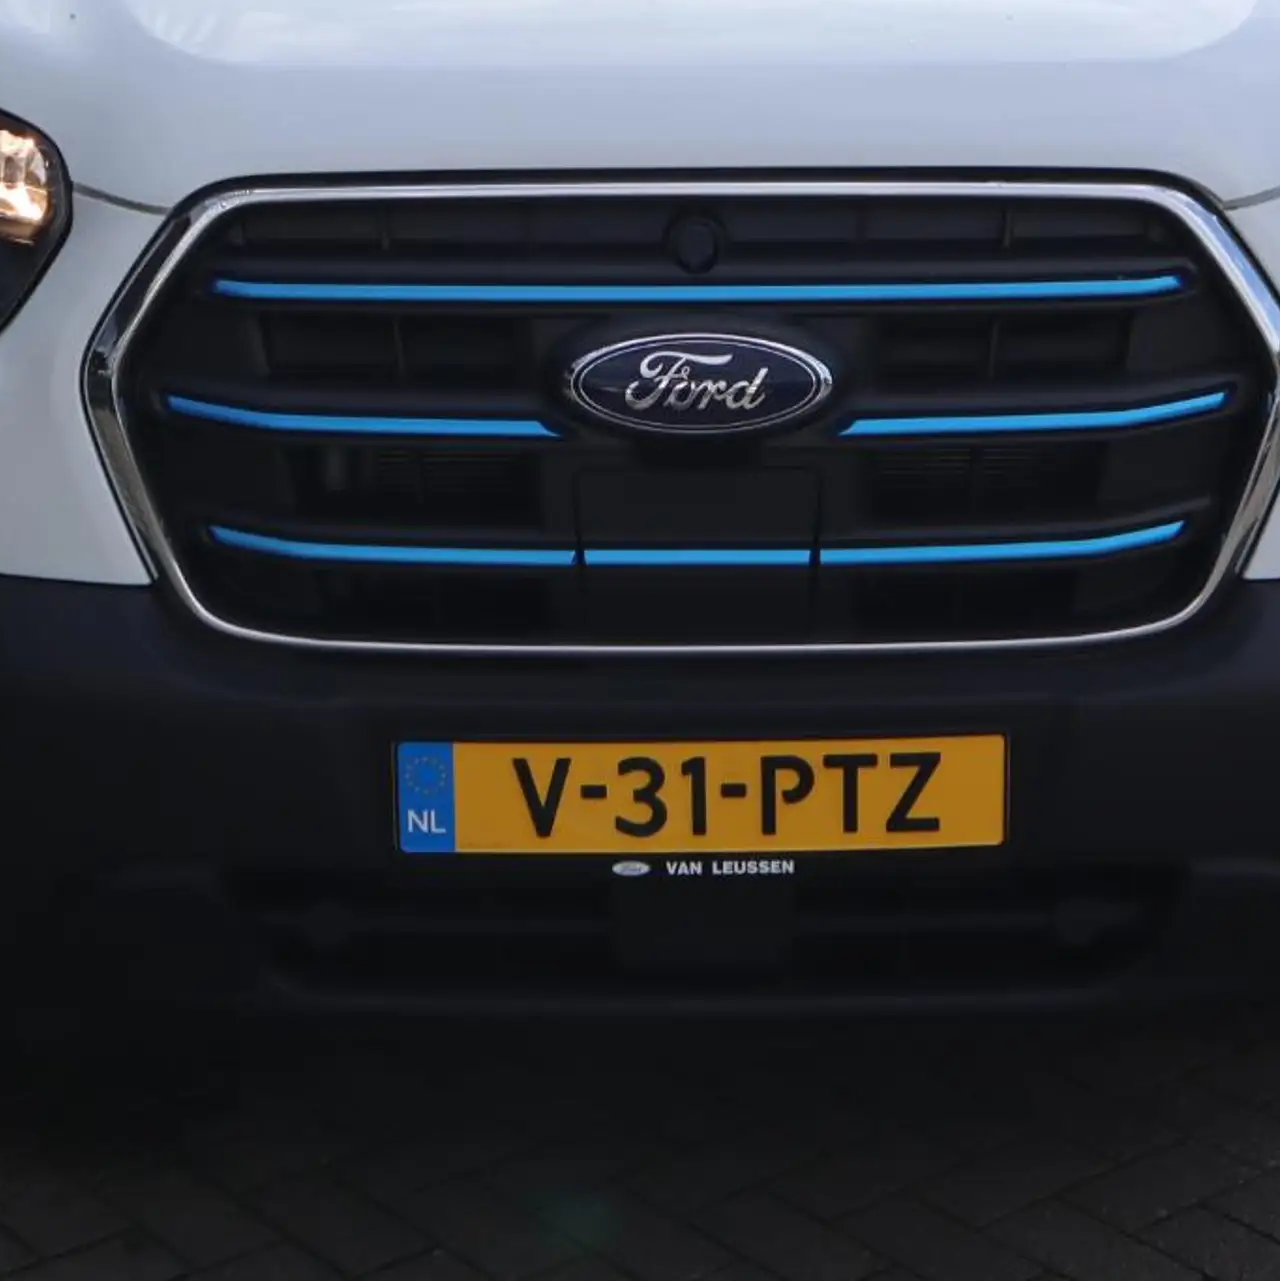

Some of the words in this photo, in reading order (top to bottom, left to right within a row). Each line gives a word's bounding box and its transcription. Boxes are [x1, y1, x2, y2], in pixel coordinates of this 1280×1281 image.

[625, 350, 769, 410] Ford
[511, 751, 942, 838] V-31-PTZ
[406, 809, 446, 834] NL
[665, 860, 703, 876] VAN
[711, 859, 796, 876] LEUSSEN
